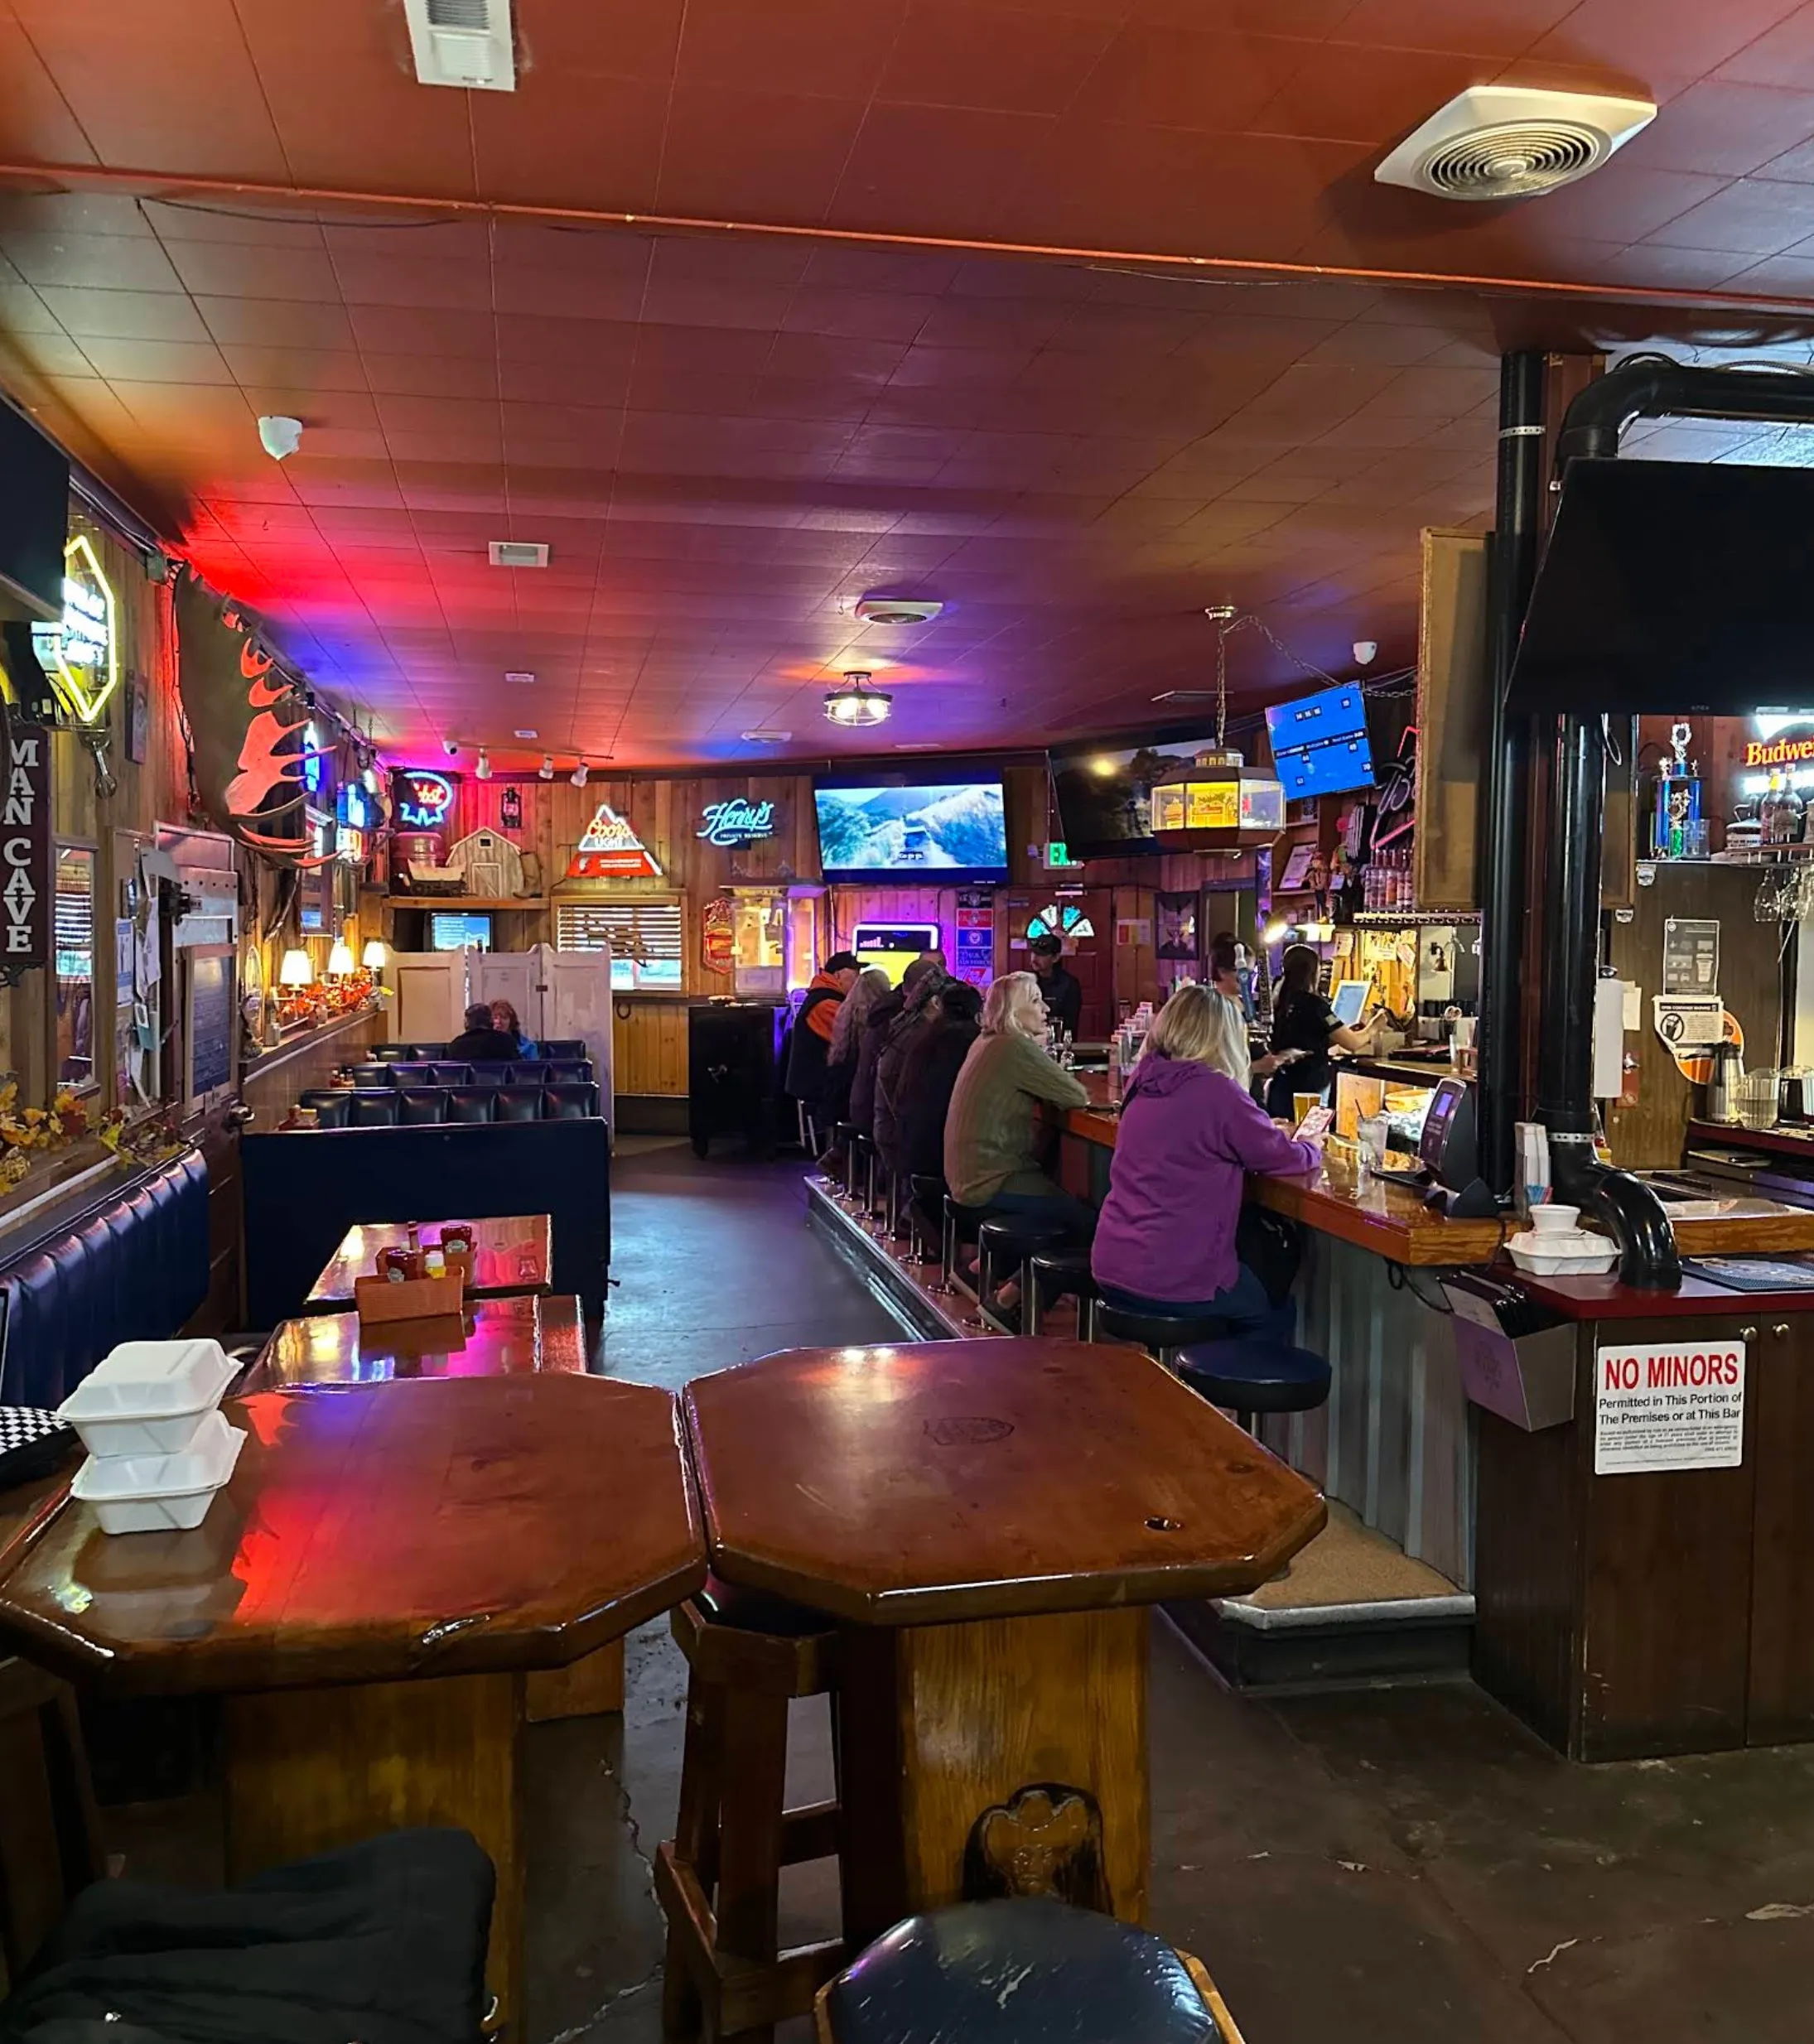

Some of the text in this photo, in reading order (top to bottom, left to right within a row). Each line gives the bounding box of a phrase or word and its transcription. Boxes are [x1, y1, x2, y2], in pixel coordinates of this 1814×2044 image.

[3, 739, 39, 826] MAN
[587, 818, 633, 838] Coors
[594, 836, 623, 848] LIGHT
[3, 837, 36, 952] CAVE
[1605, 1352, 1739, 1391] NO MINORS
[1599, 1391, 1743, 1410] Permitted in This Portion of
[1599, 1407, 1741, 1425] The Premises or at This Bar
